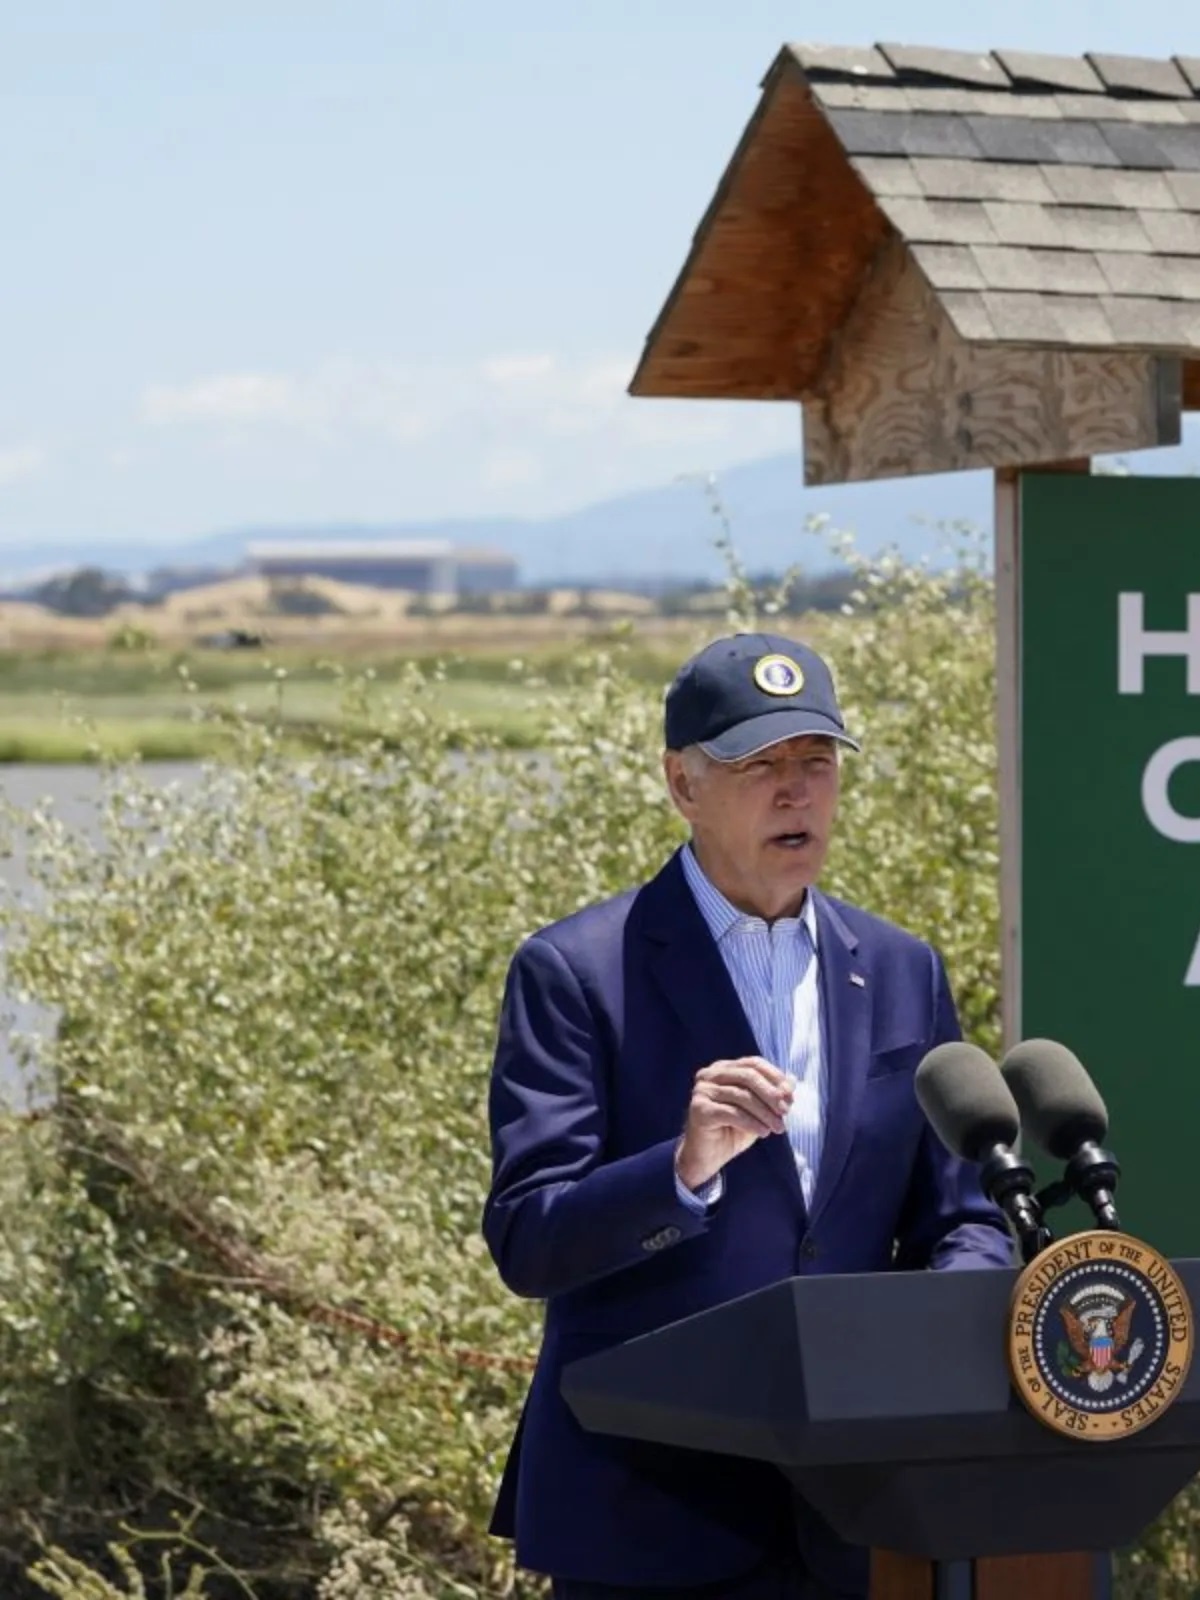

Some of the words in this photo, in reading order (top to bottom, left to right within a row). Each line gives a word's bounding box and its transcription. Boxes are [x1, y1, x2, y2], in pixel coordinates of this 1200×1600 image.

[1119, 1243, 1142, 1262] THE
[1016, 1240, 1092, 1337] PRESIDENT
[1147, 1261, 1187, 1342] UNITED
[1042, 1391, 1088, 1431] SEAL
[1120, 1362, 1181, 1428] STATES
